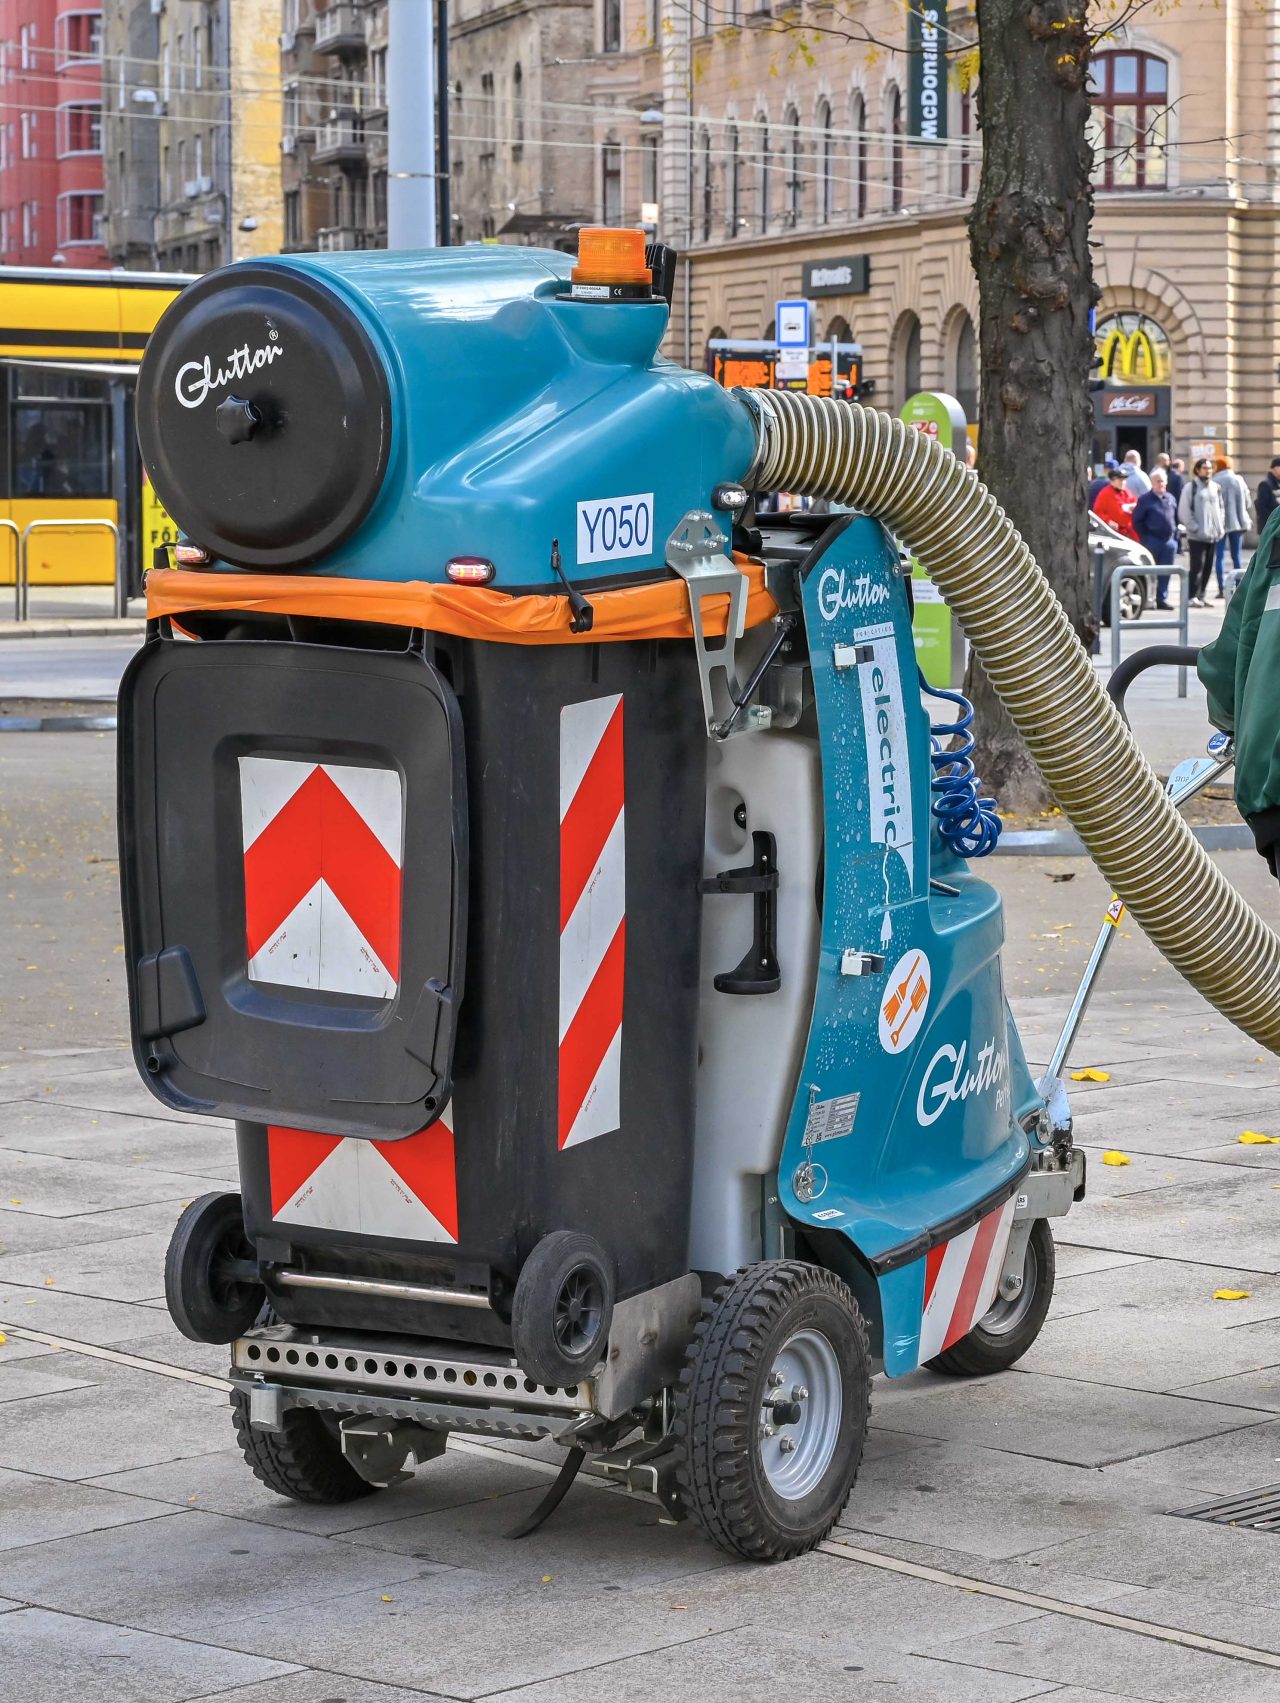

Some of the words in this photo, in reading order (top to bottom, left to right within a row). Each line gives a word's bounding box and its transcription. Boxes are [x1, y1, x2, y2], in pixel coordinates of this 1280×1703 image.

[175, 343, 283, 409] Glutton
[582, 502, 649, 553] Y050
[818, 568, 890, 620] Glutton
[871, 666, 900, 844] electric
